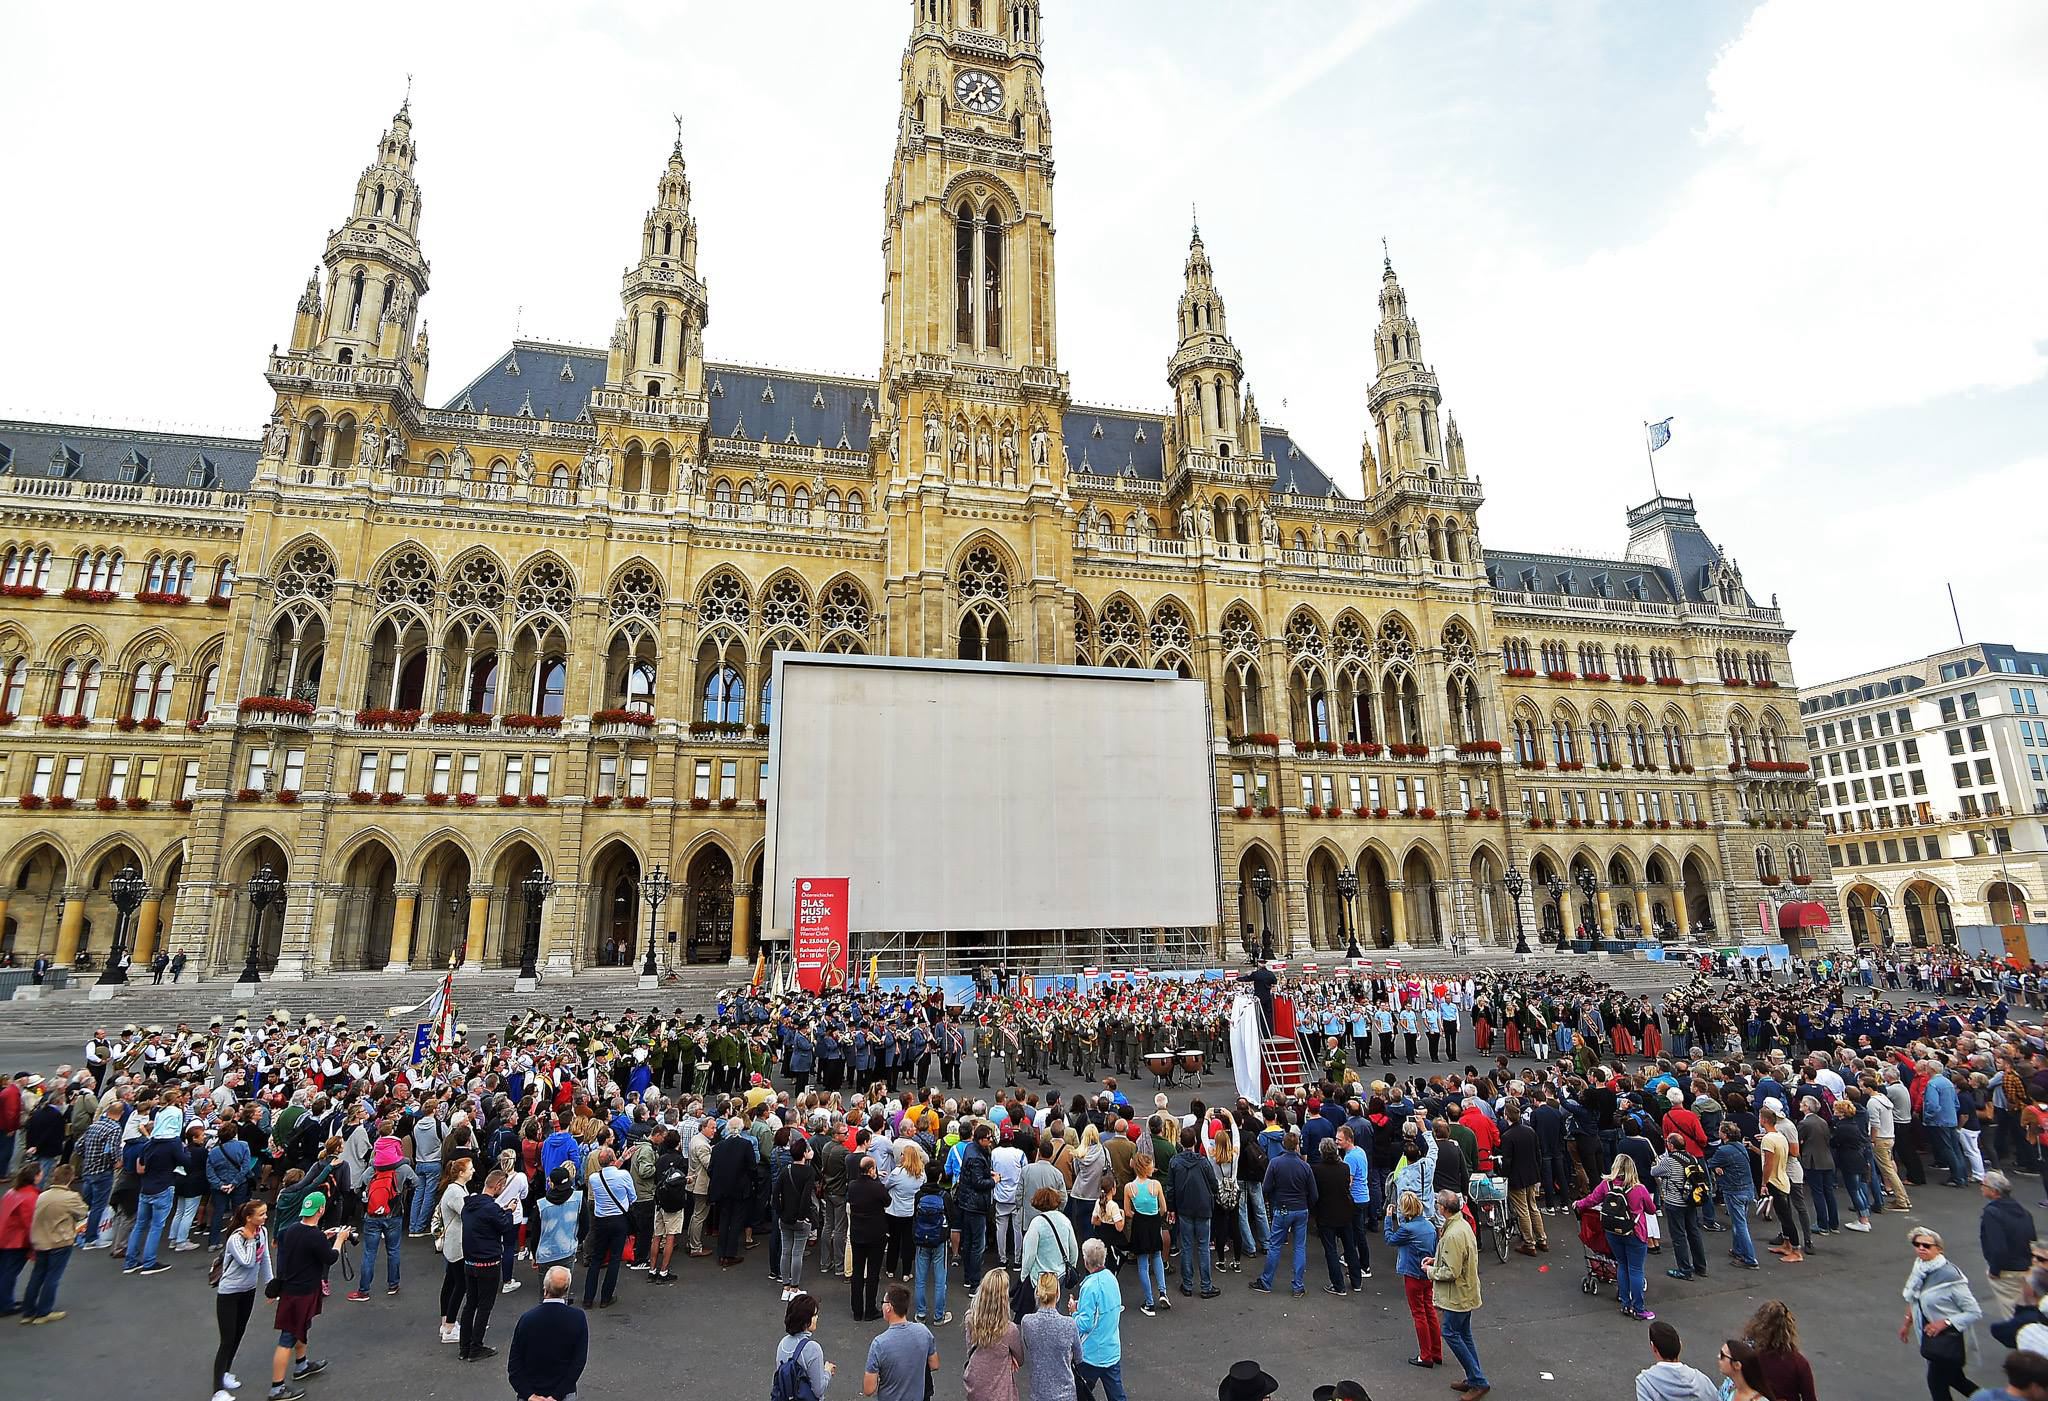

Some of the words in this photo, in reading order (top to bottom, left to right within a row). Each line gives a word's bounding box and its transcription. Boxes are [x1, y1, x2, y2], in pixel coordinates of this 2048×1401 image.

[801, 900, 824, 908] BLAS
[800, 908, 831, 916] MUSIK
[800, 916, 822, 924] FEST
